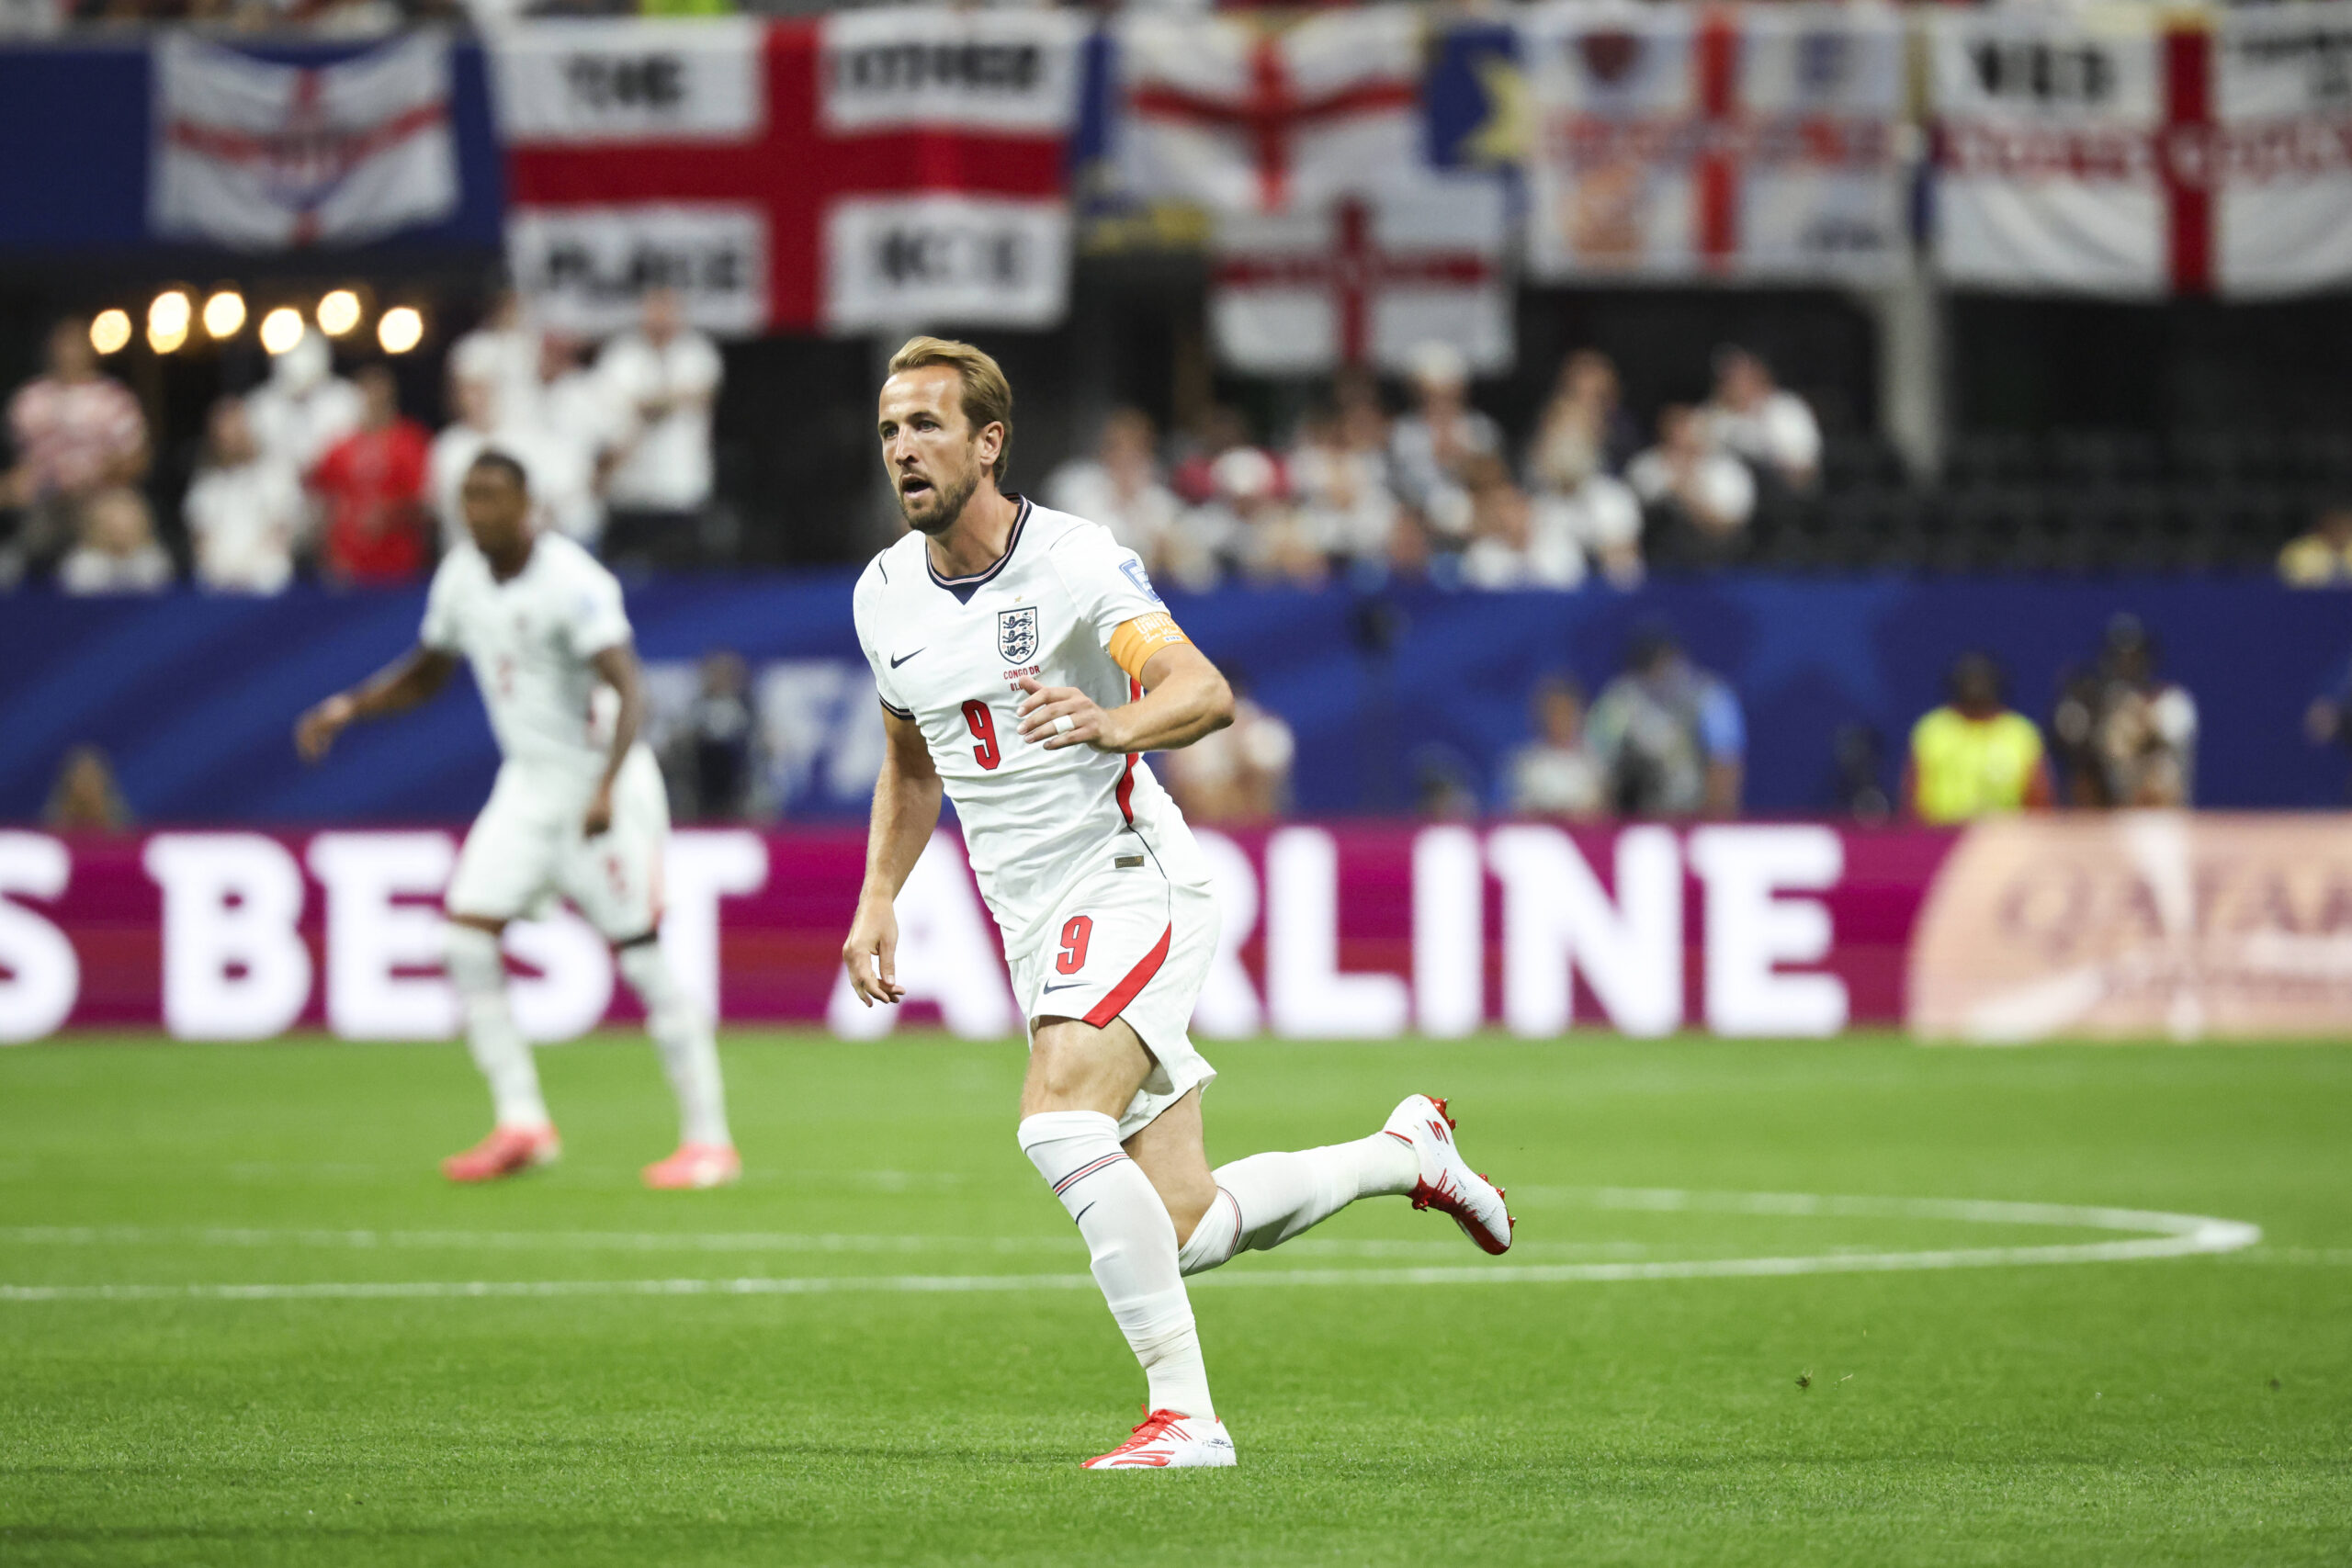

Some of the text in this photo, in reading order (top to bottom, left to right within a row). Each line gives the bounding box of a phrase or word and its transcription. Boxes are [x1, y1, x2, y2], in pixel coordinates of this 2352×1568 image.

[565, 50, 684, 108] THE
[1003, 665, 1041, 680] CONGO DR
[961, 699, 1001, 771] 9
[827, 824, 1849, 1041] ARLINE
[1056, 915, 1093, 975] 9
